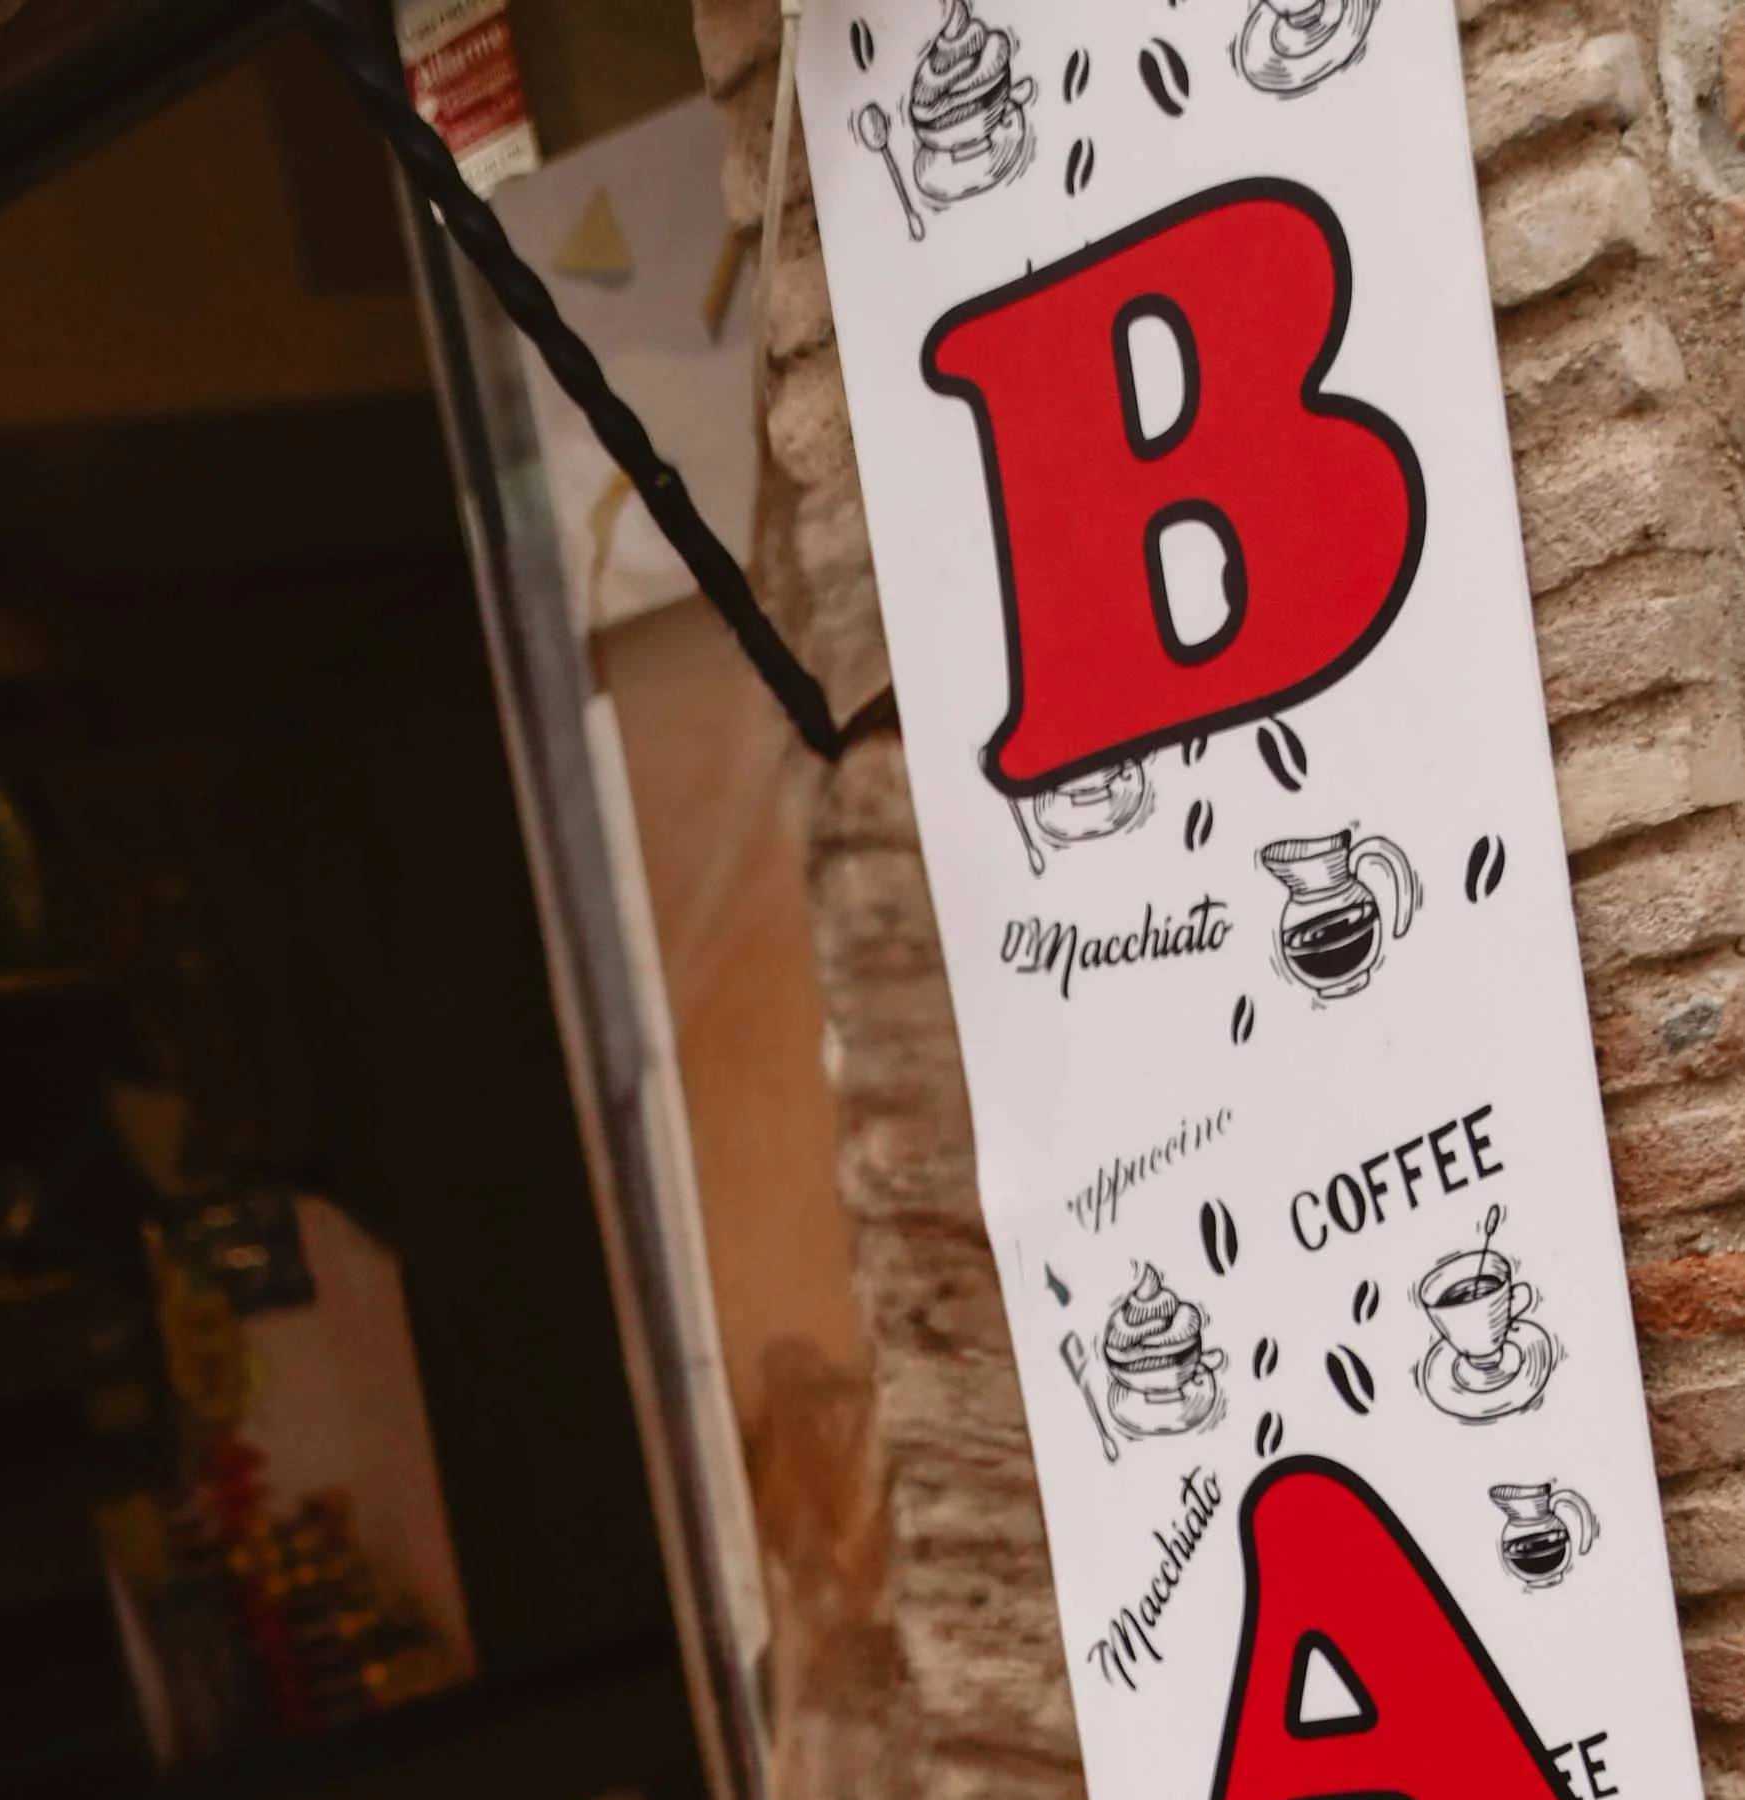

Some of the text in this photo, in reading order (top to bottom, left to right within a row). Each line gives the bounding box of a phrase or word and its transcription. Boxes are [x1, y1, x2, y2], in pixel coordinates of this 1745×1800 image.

[1066, 1106, 1233, 1234] appuccino
[1288, 1104, 1504, 1252] COFFEE
[1087, 1464, 1222, 1692] Macchiato
